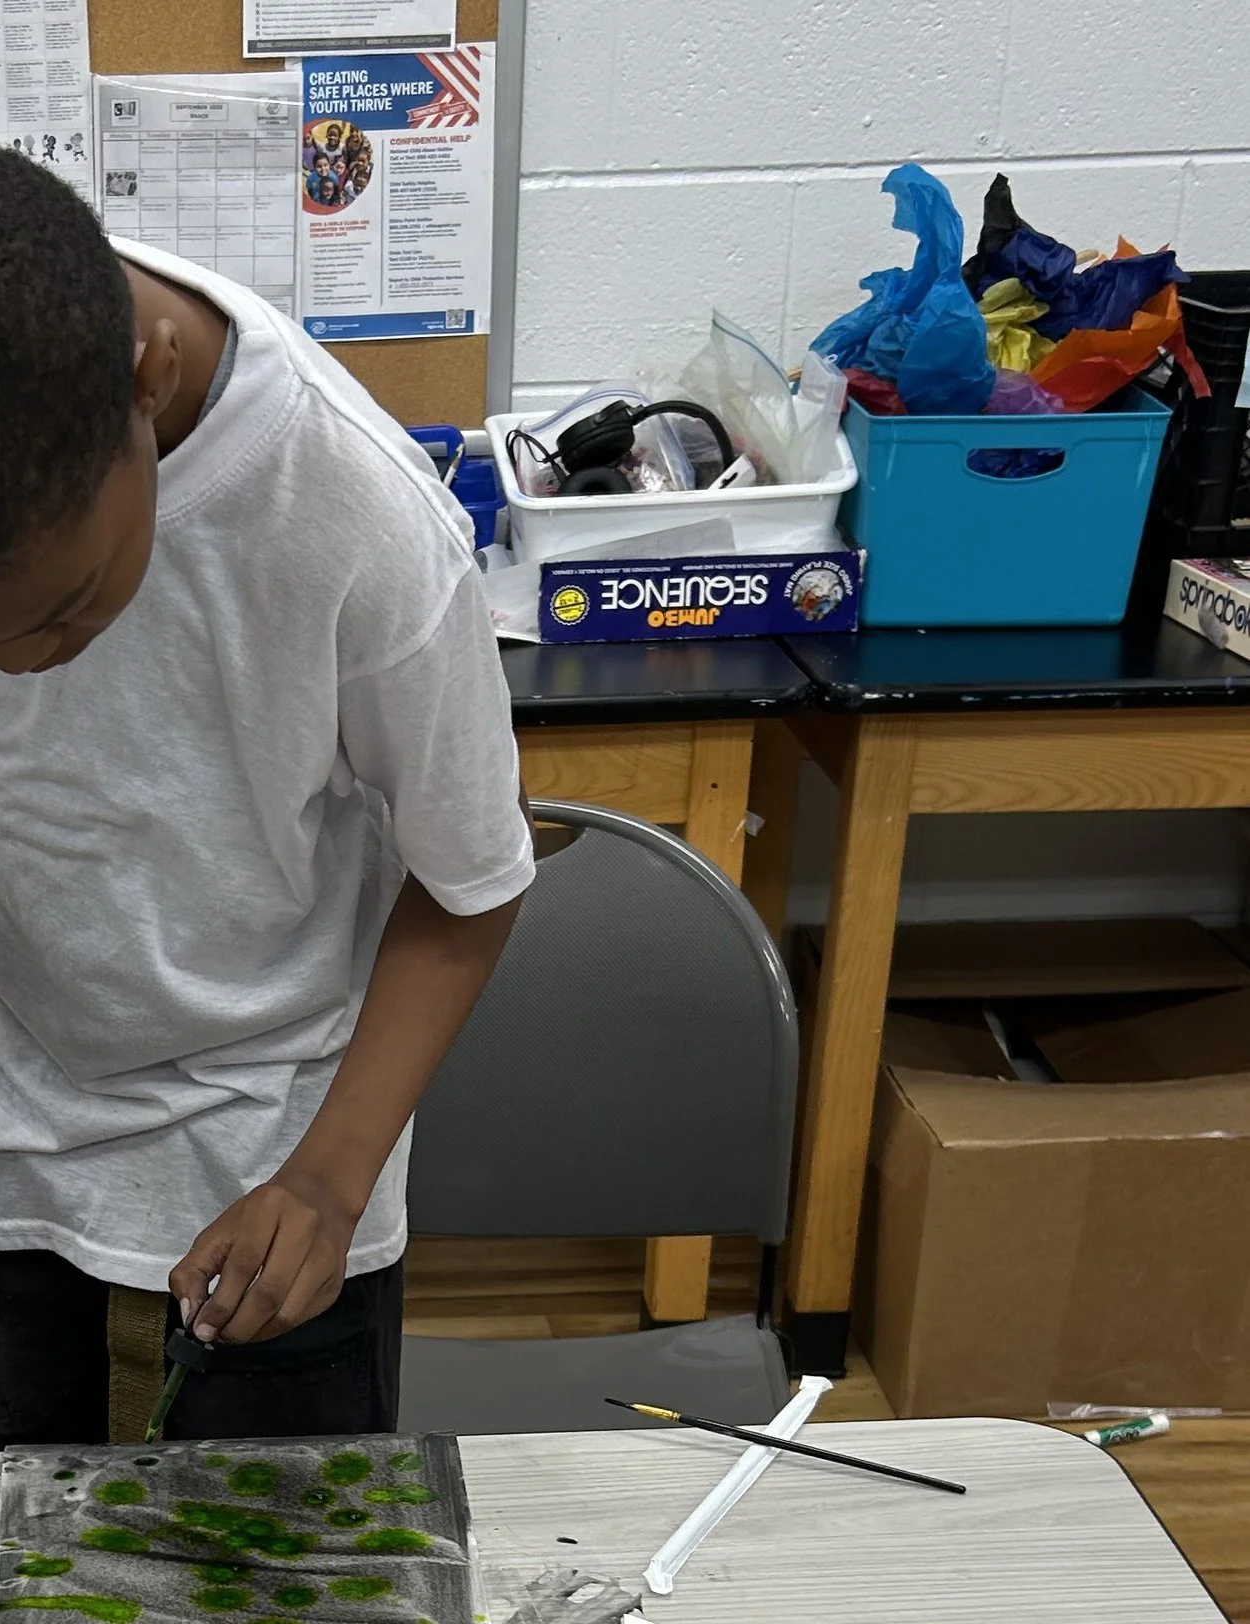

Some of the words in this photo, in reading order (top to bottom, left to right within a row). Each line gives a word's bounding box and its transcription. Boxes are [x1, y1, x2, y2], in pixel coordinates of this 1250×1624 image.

[309, 69, 368, 86] CREATING
[309, 86, 341, 100] SAFE
[342, 84, 389, 98] PLACES
[390, 81, 434, 96] WHERE
[308, 101, 350, 114] YOUTH
[351, 97, 393, 112] THRIVE
[390, 136, 447, 145] CONFIDENTIAL
[450, 134, 471, 143] HELP
[601, 574, 769, 610] SEQUENCE
[647, 607, 721, 627] JUMBO
